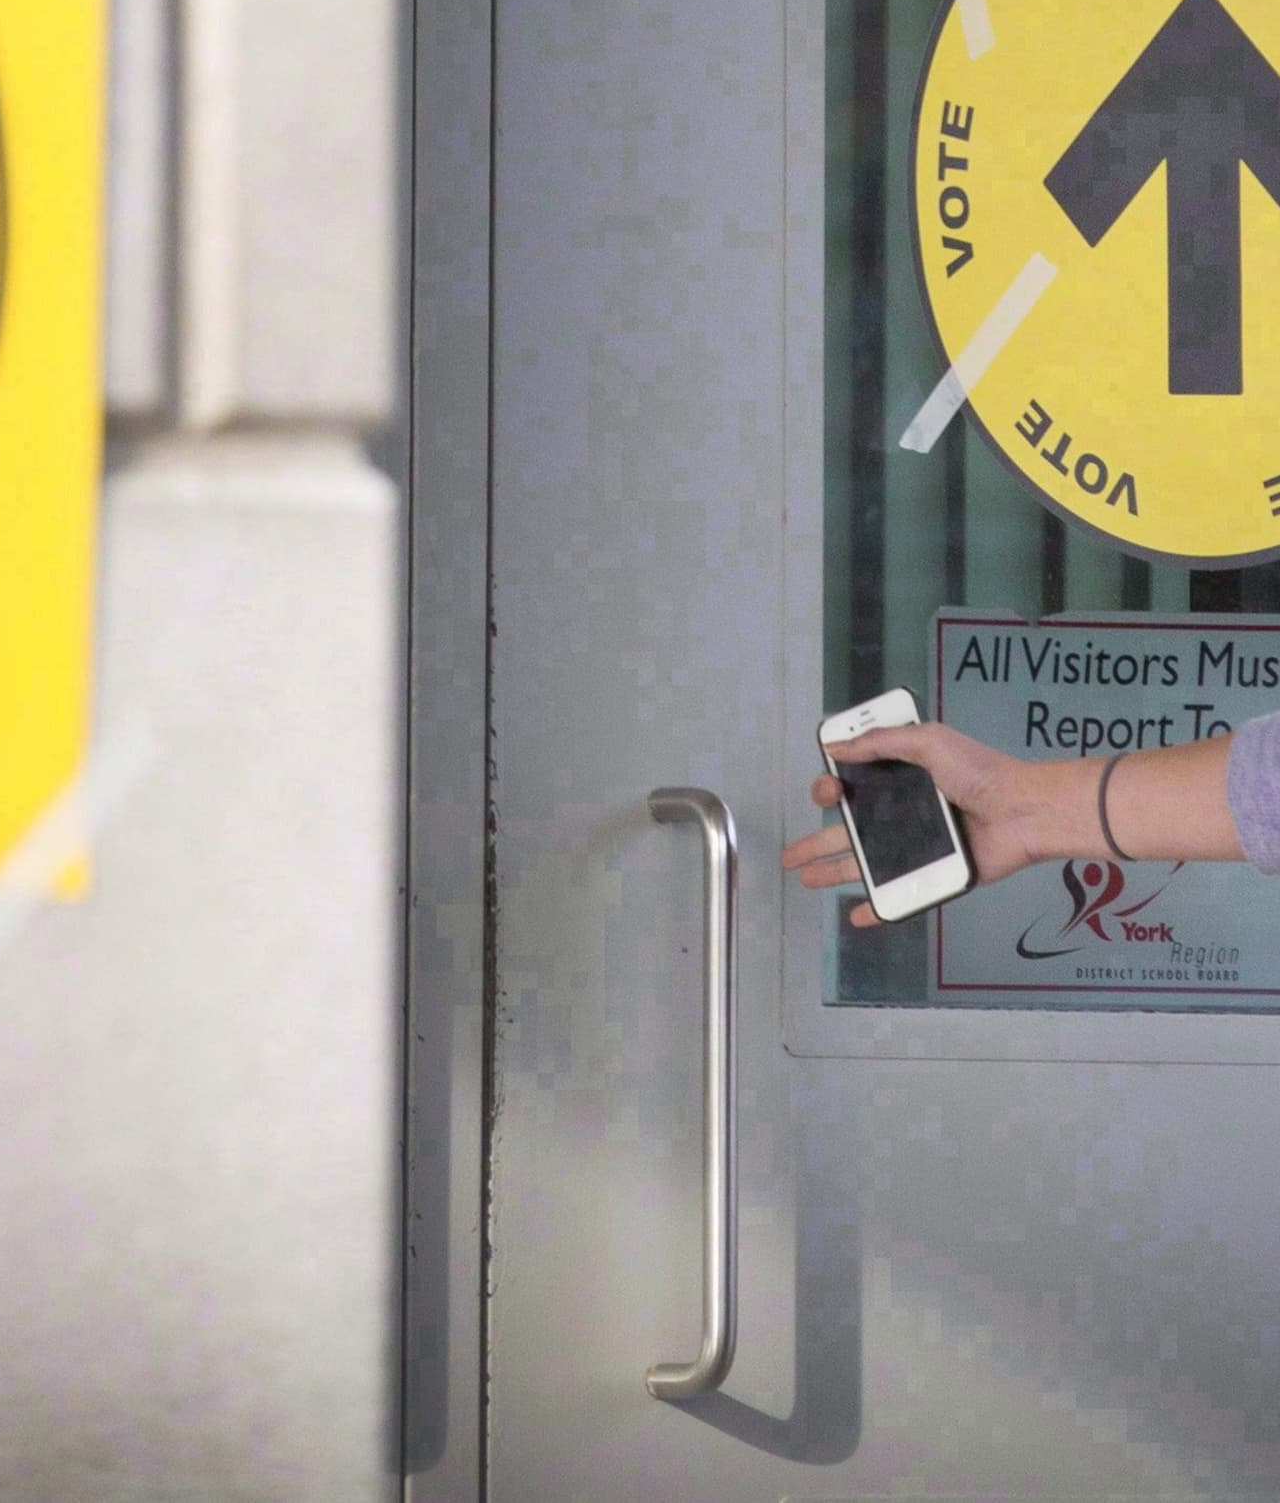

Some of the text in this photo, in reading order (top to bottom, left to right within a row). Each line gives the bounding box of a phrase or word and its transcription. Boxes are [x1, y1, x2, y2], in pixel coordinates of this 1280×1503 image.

[937, 100, 975, 278] VOTE
[1014, 399, 1140, 516] VOTE
[955, 636, 1011, 682] All
[1021, 637, 1179, 686] Visitors
[1026, 701, 1174, 757] Report
[1121, 922, 1175, 943] York
[1170, 941, 1240, 968] Region
[1076, 967, 1240, 982] DISTRICT SCHOOL BOARD
